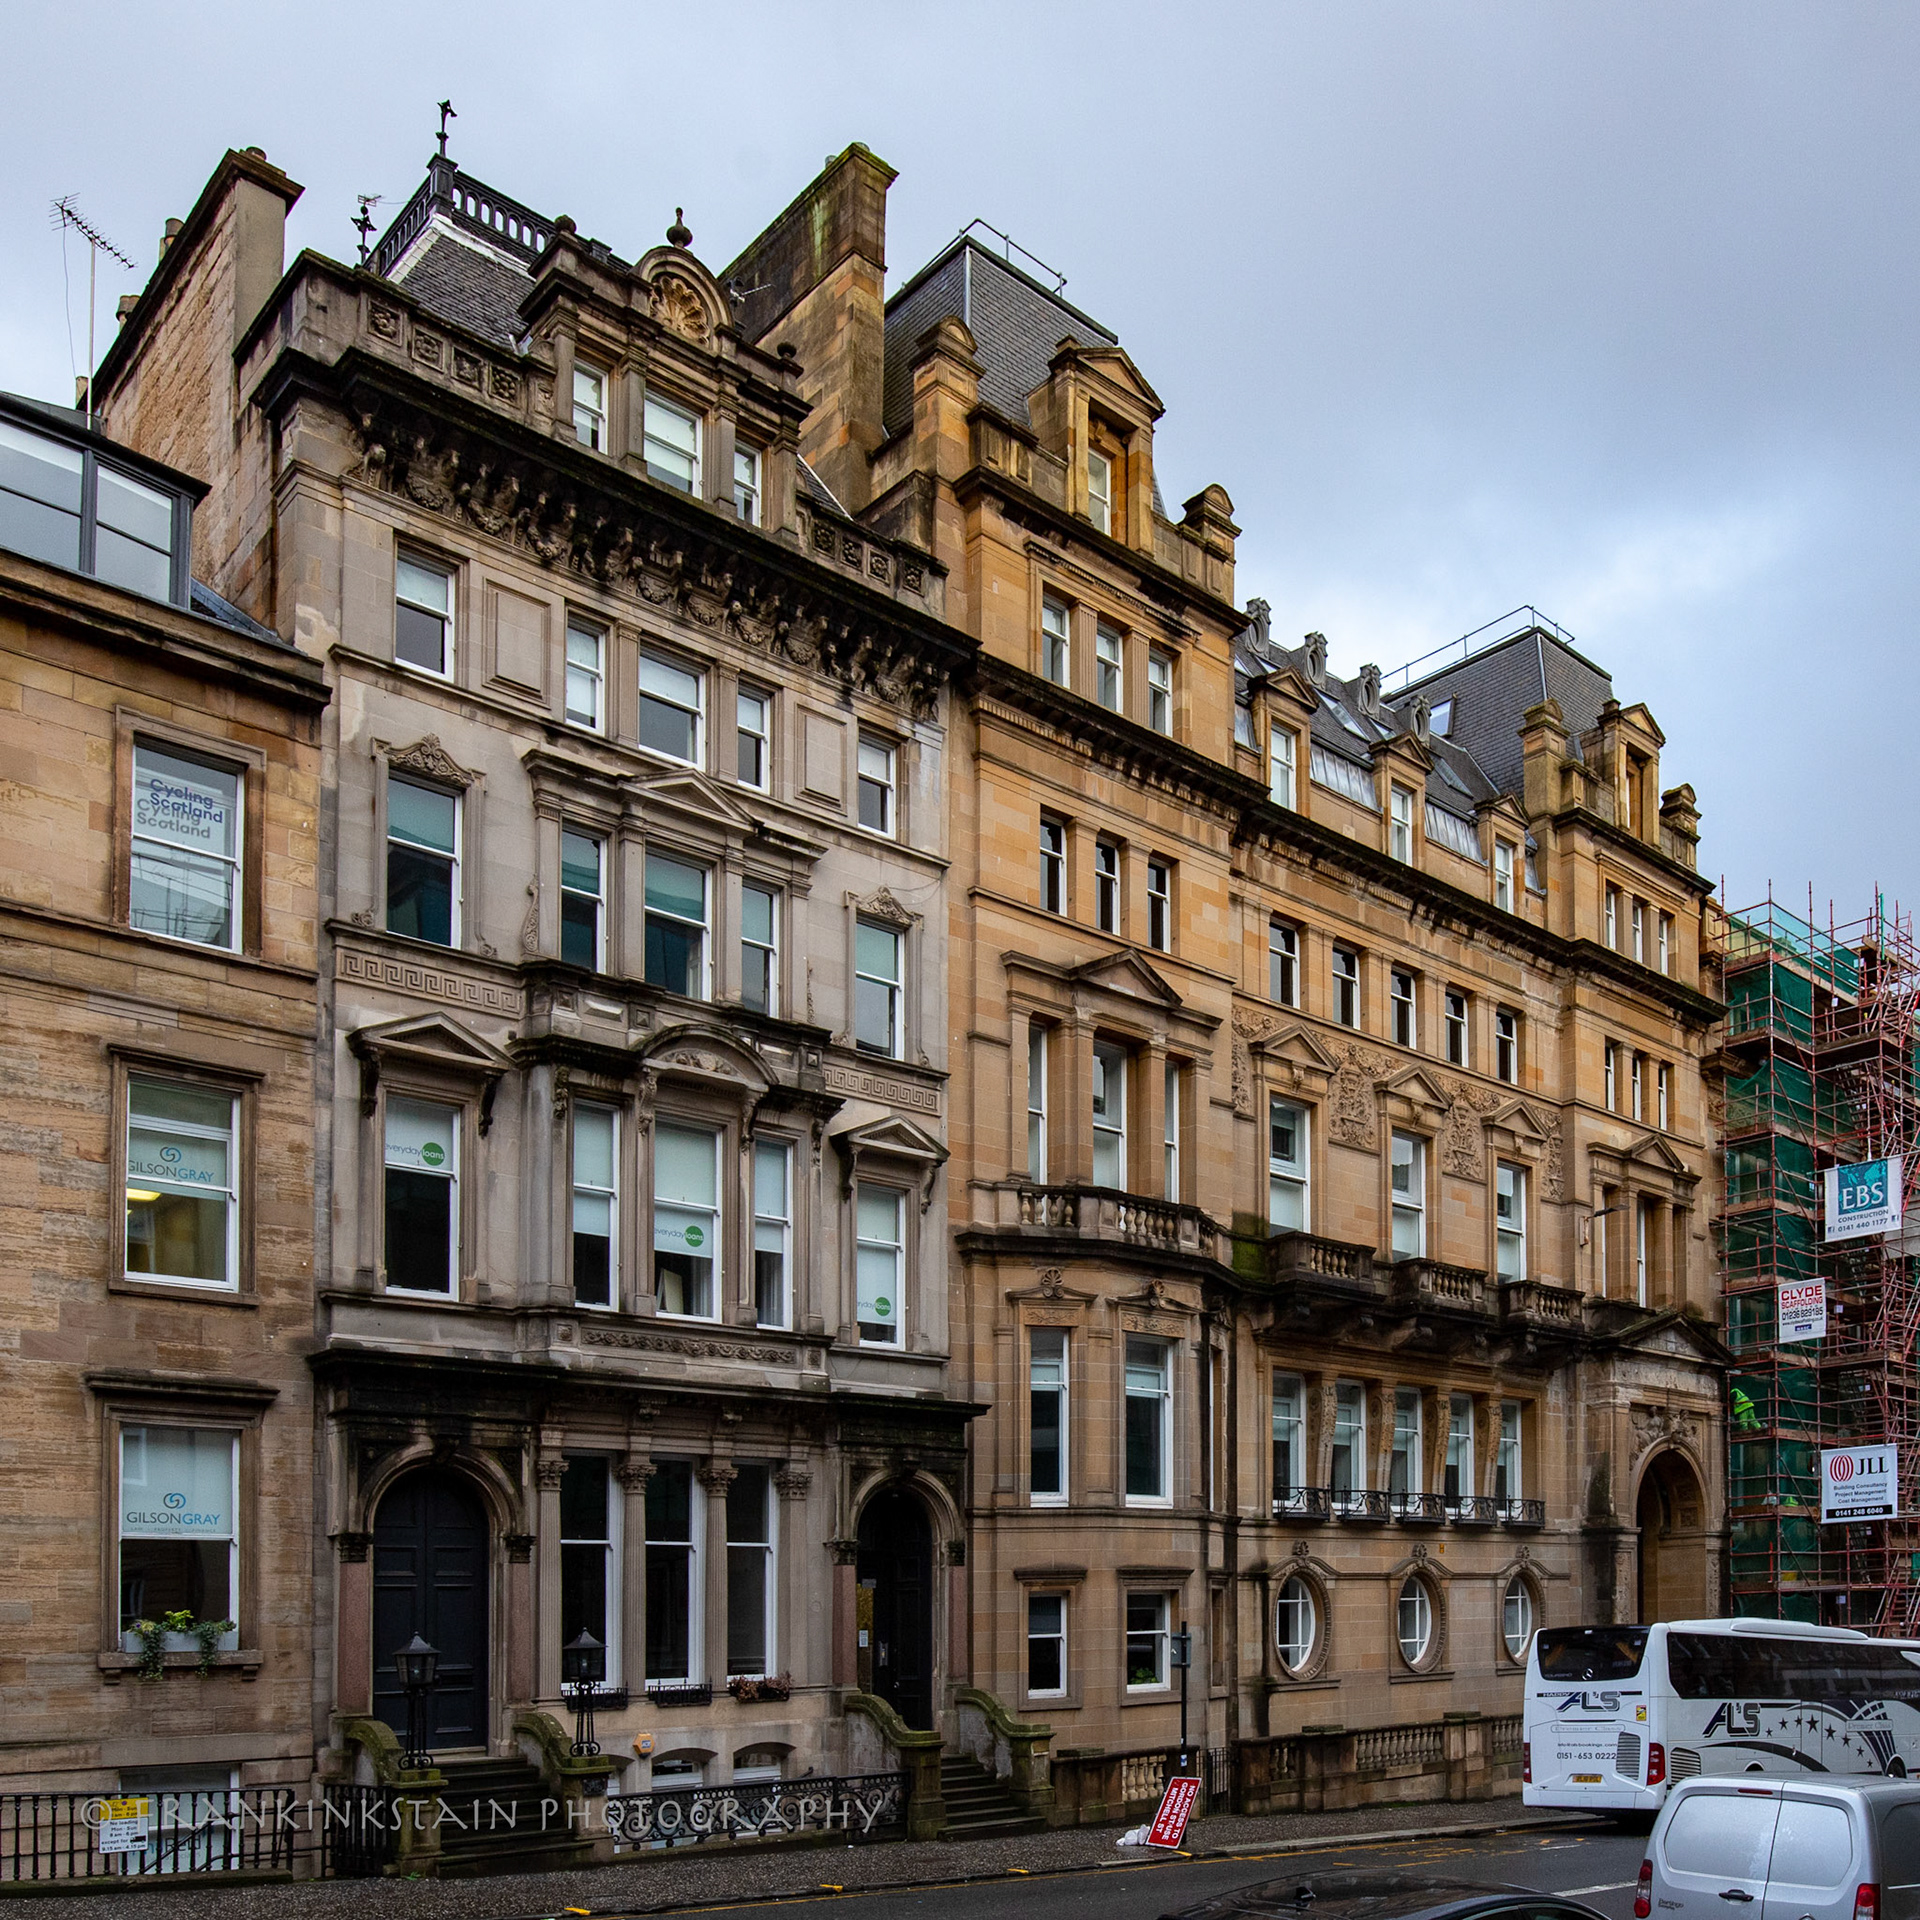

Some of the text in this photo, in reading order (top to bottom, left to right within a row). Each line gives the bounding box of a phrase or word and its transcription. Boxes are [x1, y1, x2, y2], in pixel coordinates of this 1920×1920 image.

[150, 779, 213, 809] Cycling
[150, 793, 222, 823] Scotland
[128, 1160, 214, 1182] GILSONGRAY
[1843, 1182, 1884, 1210] EBS
[1838, 1209, 1888, 1224] CONSTRUCTION
[1838, 1224, 1854, 1232] 0141
[1856, 1221, 1870, 1229] 440
[1872, 1218, 1888, 1226] 1177
[1781, 1285, 1822, 1301] CLYDE
[1781, 1296, 1822, 1310] SCAFFOLDING
[1855, 1456, 1890, 1476] JLL
[126, 1512, 220, 1525] GILSONGRAY
[1172, 1782, 1188, 1813] GORDON
[1156, 1787, 1179, 1833] MITCHELL ST
[1172, 1786, 1196, 1839] NO ACCESS TO
